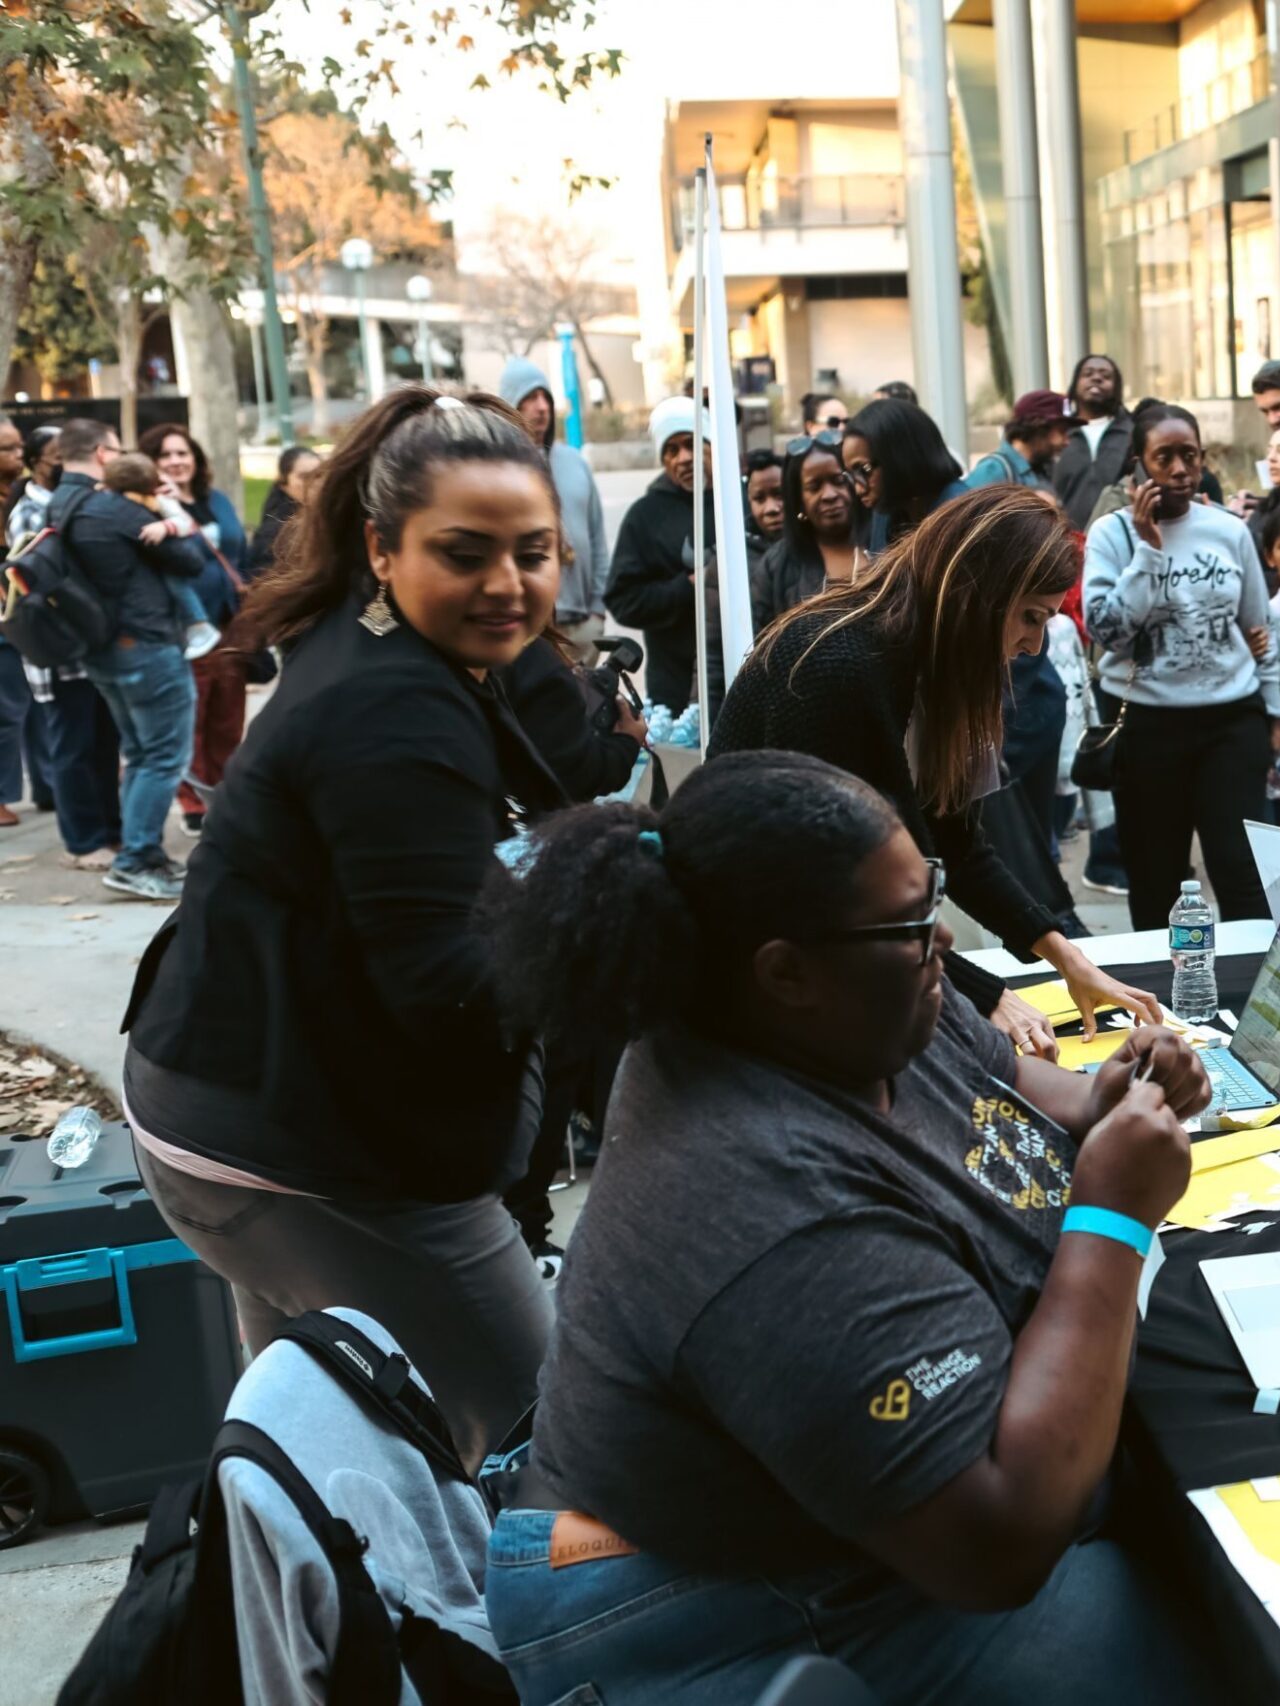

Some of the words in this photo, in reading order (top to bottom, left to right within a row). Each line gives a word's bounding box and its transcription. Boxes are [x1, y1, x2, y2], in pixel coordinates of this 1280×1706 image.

[904, 1358, 931, 1382] THE
[913, 1348, 966, 1391] CHANGE
[921, 1353, 982, 1402] REACTION
